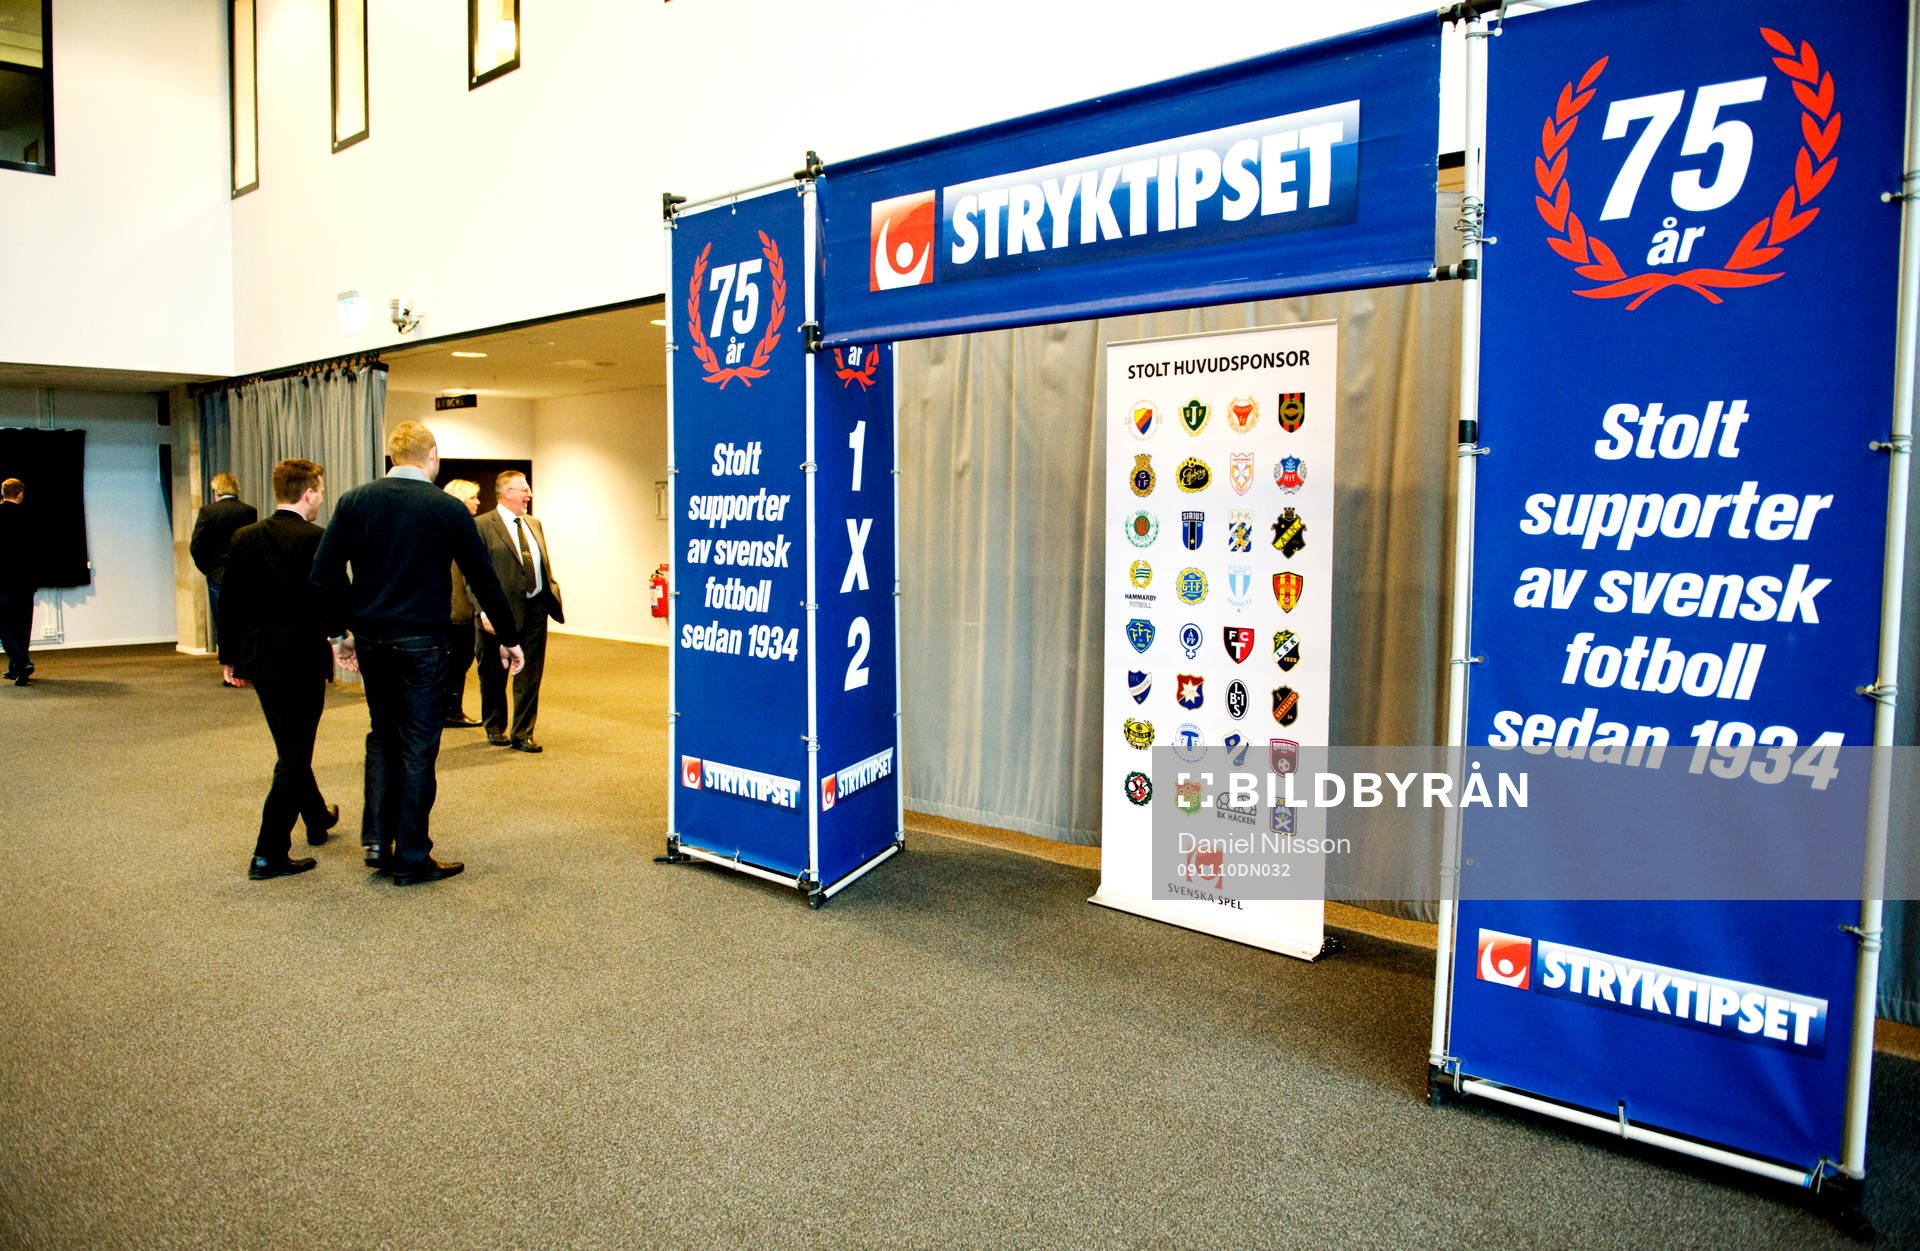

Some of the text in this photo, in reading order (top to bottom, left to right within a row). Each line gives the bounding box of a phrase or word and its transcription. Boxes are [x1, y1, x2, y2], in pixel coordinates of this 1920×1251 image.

[1600, 76, 1767, 222] 75
[952, 121, 1343, 265] STRYKTIPSET
[1647, 217, 1705, 265] år
[709, 259, 762, 338] 75
[726, 336, 745, 365] år
[1128, 350, 1310, 379] STOLT HUVUDSPONSOR
[712, 442, 761, 476] Stolt
[849, 421, 865, 491] 1
[1595, 400, 1749, 460] Stolt
[688, 488, 790, 528] supporter
[1520, 481, 1833, 550] supporter
[687, 538, 791, 567] av svensk
[840, 519, 872, 593] X
[705, 576, 771, 612] fotboll
[1514, 564, 1832, 624] av svensk
[681, 621, 799, 661] sedan 1934
[844, 617, 870, 691] 2
[1562, 633, 1766, 700] fotboll
[838, 754, 892, 798] STRYKTIPSET
[1488, 707, 1844, 790] sedan 1934
[705, 766, 799, 808] STRYKTIPSET
[1168, 883, 1243, 910] SVENSKA SPEL
[1543, 951, 1818, 1046] STRYKTIPSET
